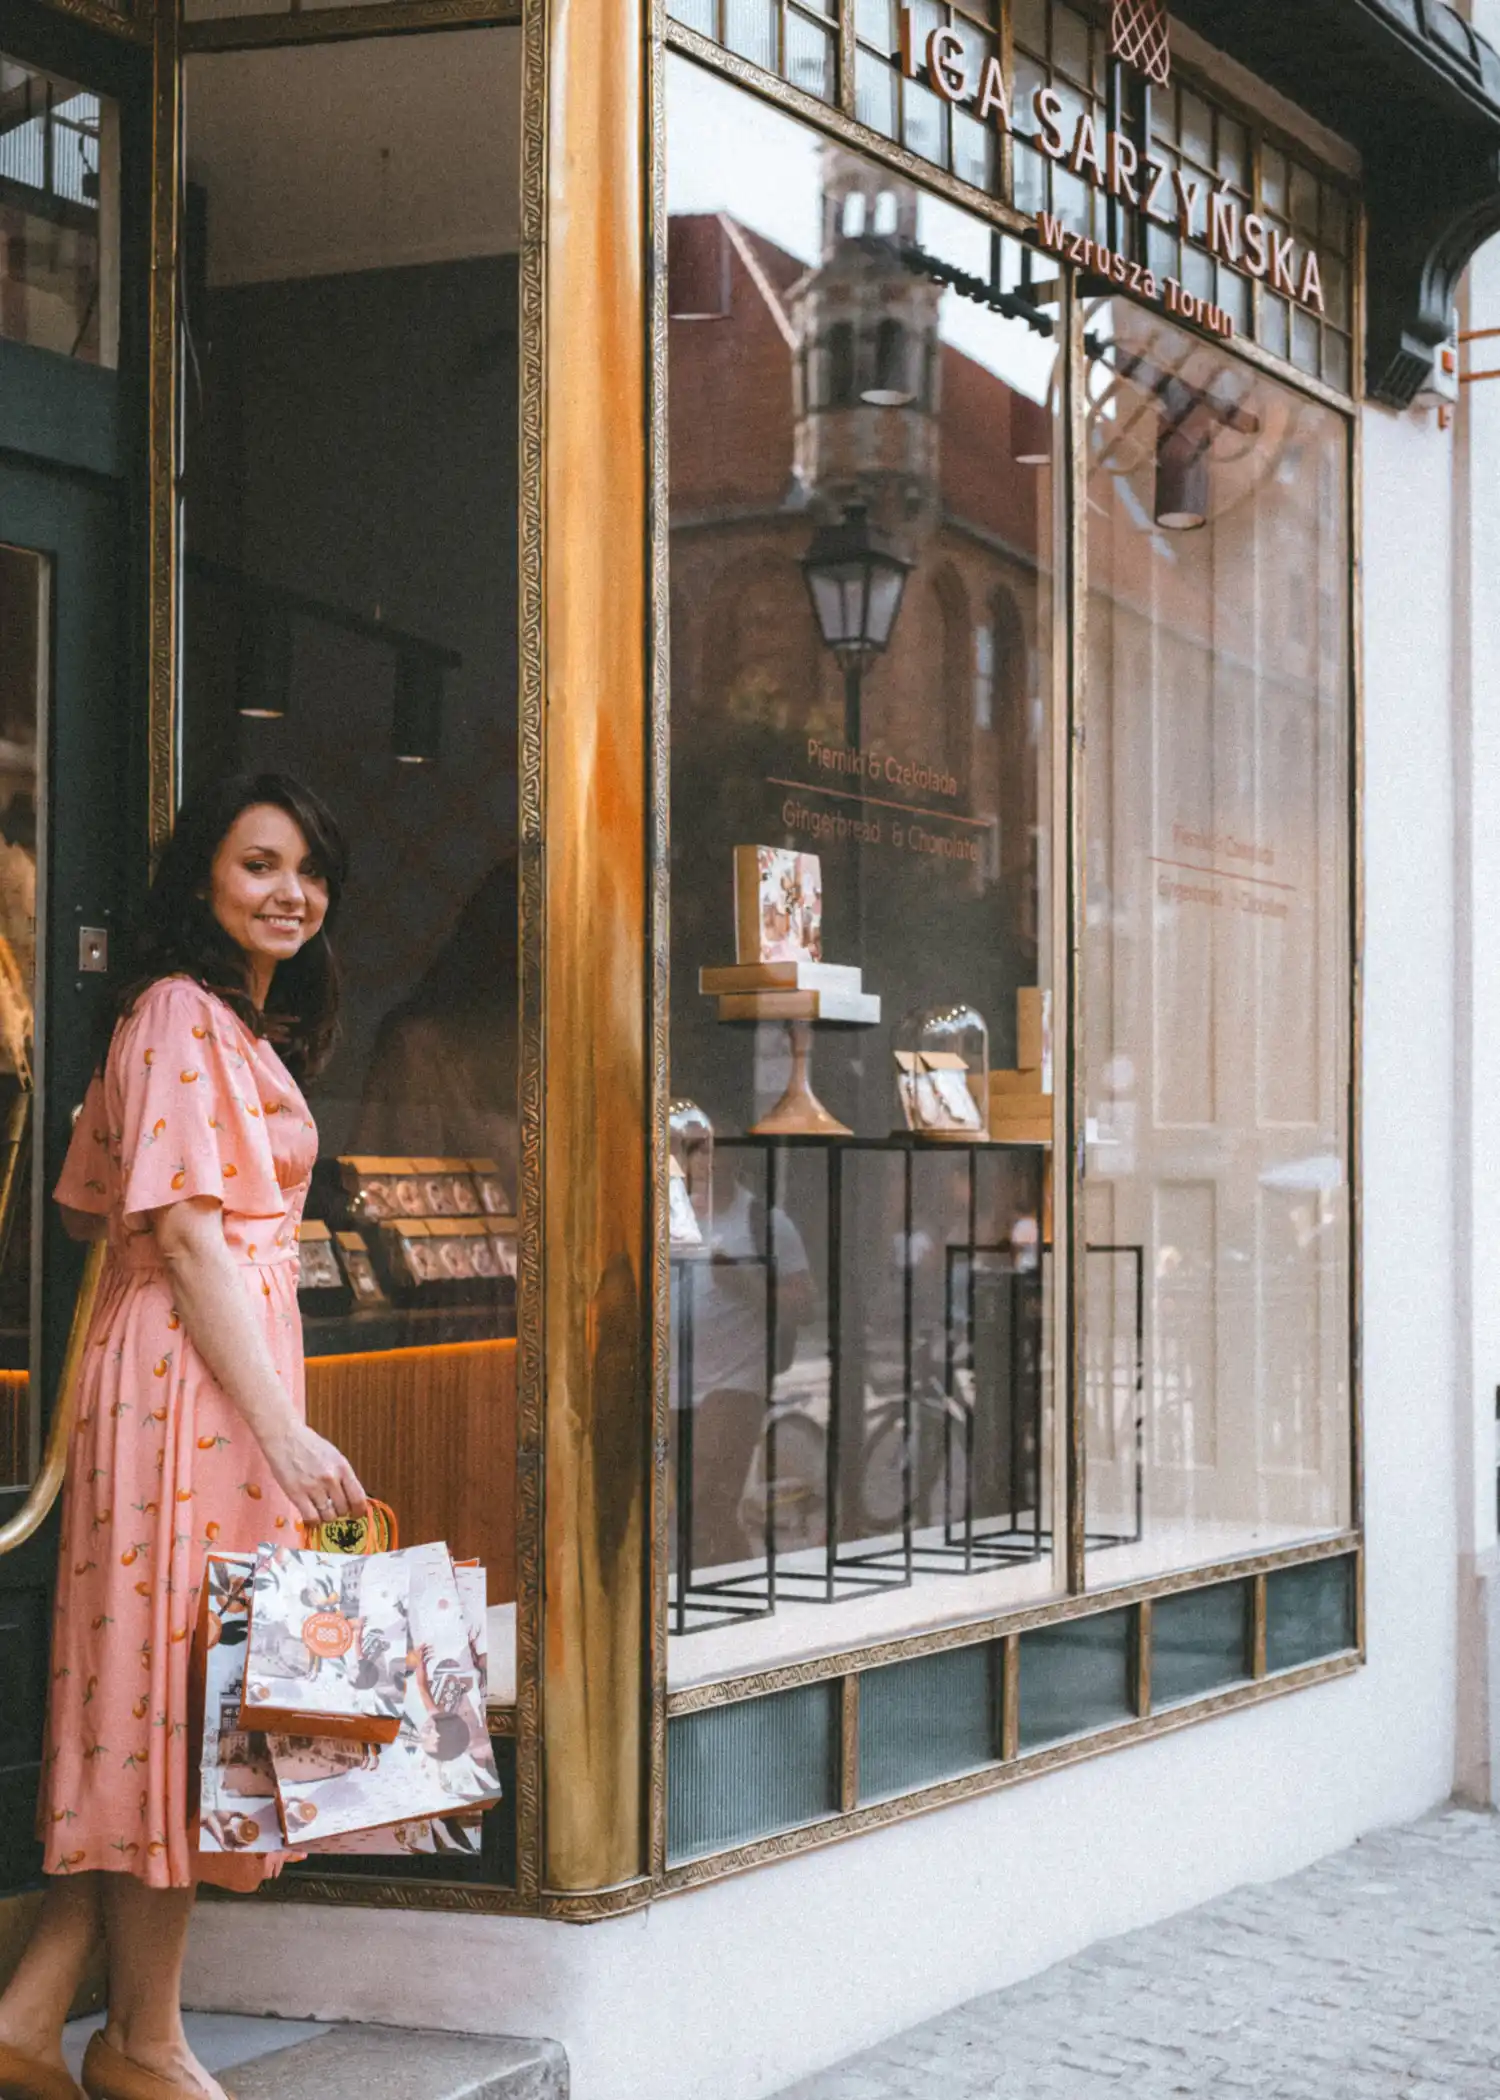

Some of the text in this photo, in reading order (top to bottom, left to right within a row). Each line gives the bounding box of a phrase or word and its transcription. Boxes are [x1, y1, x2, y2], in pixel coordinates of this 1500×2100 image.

[901, 5, 1325, 312] IGA SARZYŃSKA
[1037, 210, 1158, 300] Wzrusza
[808, 738, 864, 776] Pierniki
[885, 756, 957, 796] Czekolada
[782, 799, 880, 844] Gingerbread
